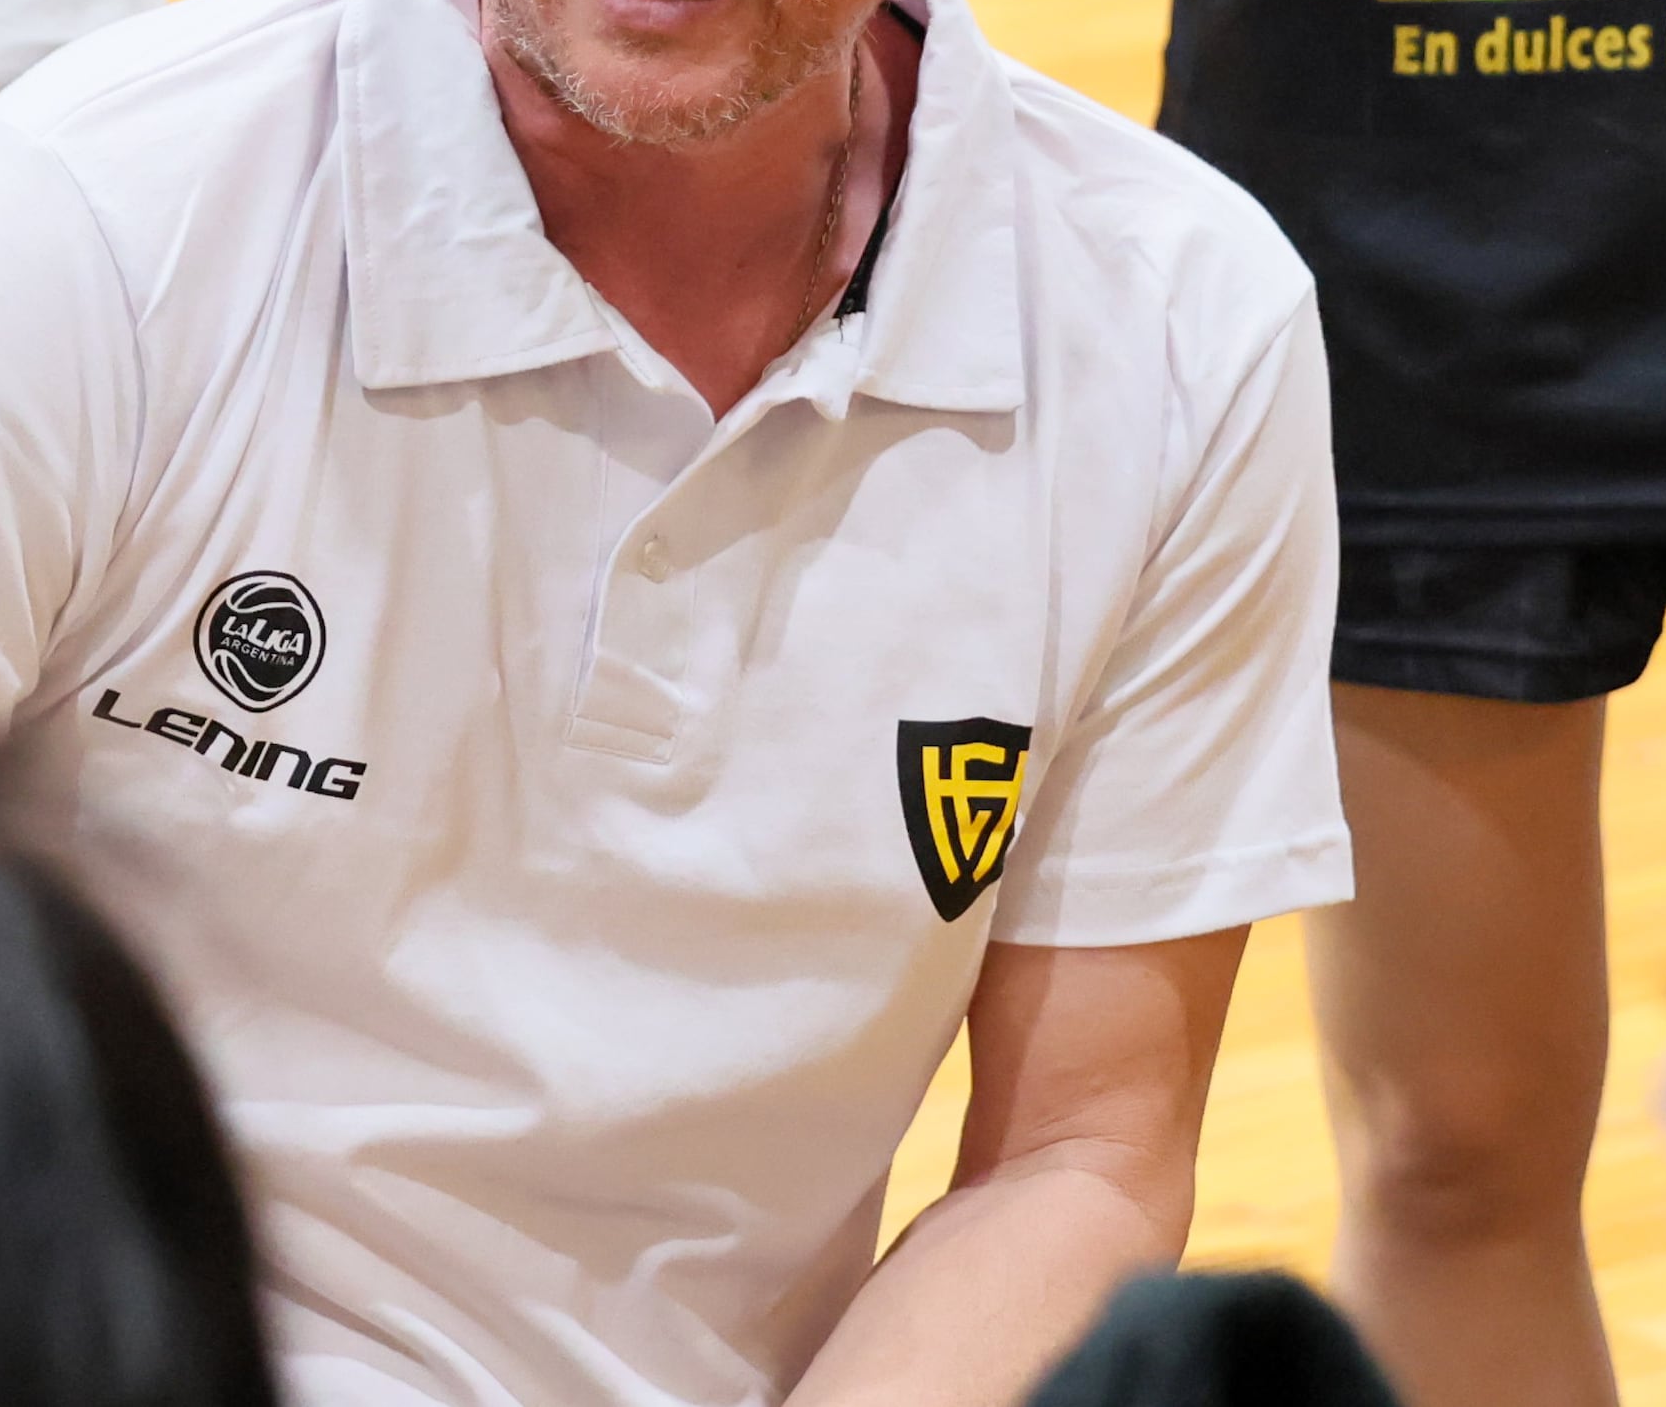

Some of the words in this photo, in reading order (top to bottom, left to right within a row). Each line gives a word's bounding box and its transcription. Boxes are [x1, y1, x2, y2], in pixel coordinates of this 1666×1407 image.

[1393, 24, 1457, 75] En
[1475, 14, 1652, 75] dulces
[220, 637, 295, 667] ARGENTINA
[92, 689, 368, 800] LENING
